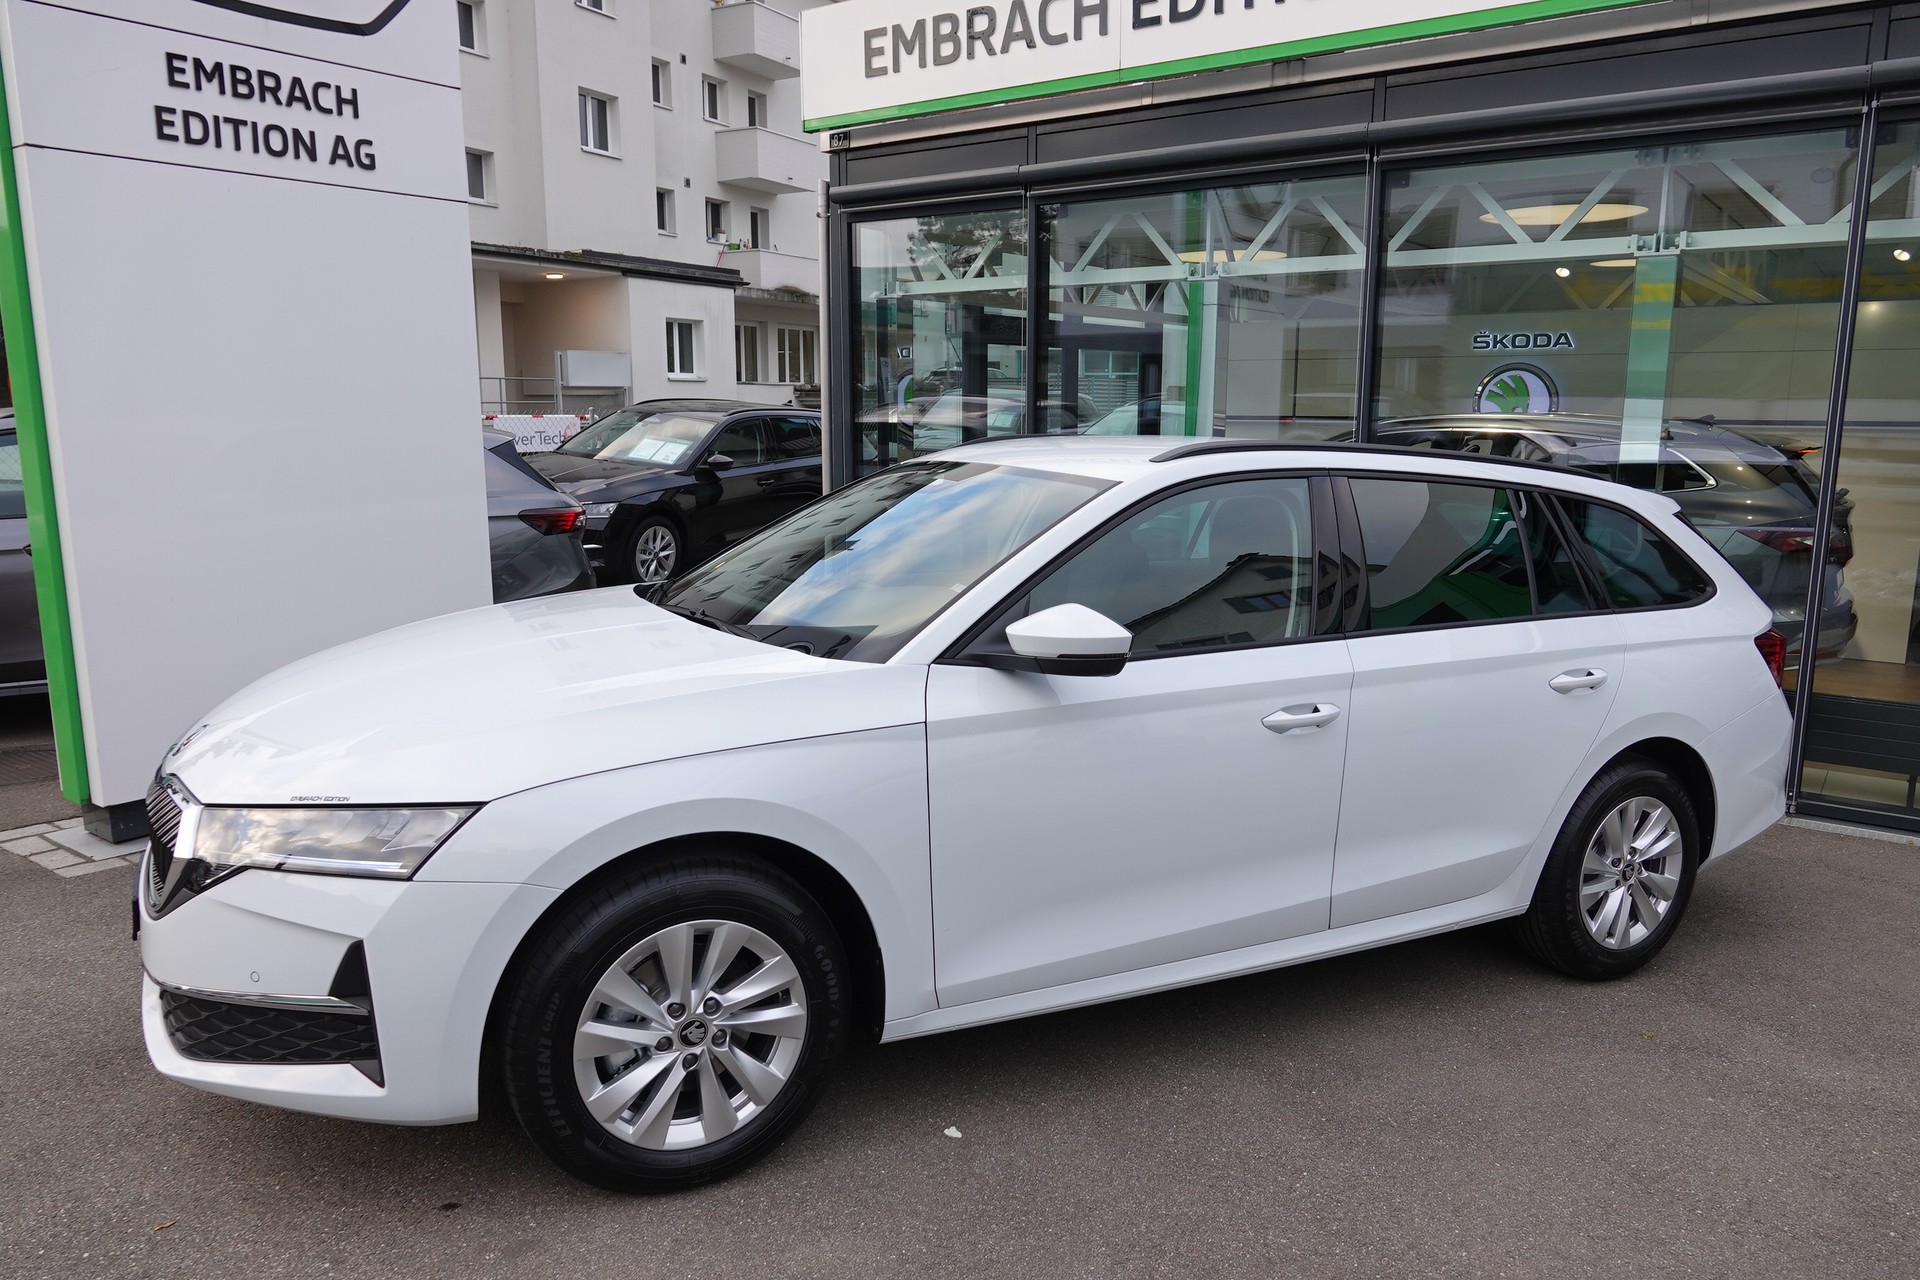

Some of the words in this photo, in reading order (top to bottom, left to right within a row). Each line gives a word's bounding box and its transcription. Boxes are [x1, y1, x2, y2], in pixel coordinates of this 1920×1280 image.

[864, 0, 1108, 78] EMBRACH
[165, 51, 360, 119] EMBRACH
[154, 105, 317, 162] EDITION
[329, 134, 377, 171] AG
[833, 133, 845, 147] 87
[1472, 331, 1574, 350] ŠKODA
[541, 991, 561, 1033] GRIP
[536, 1036, 573, 1138] EFFICIENT
